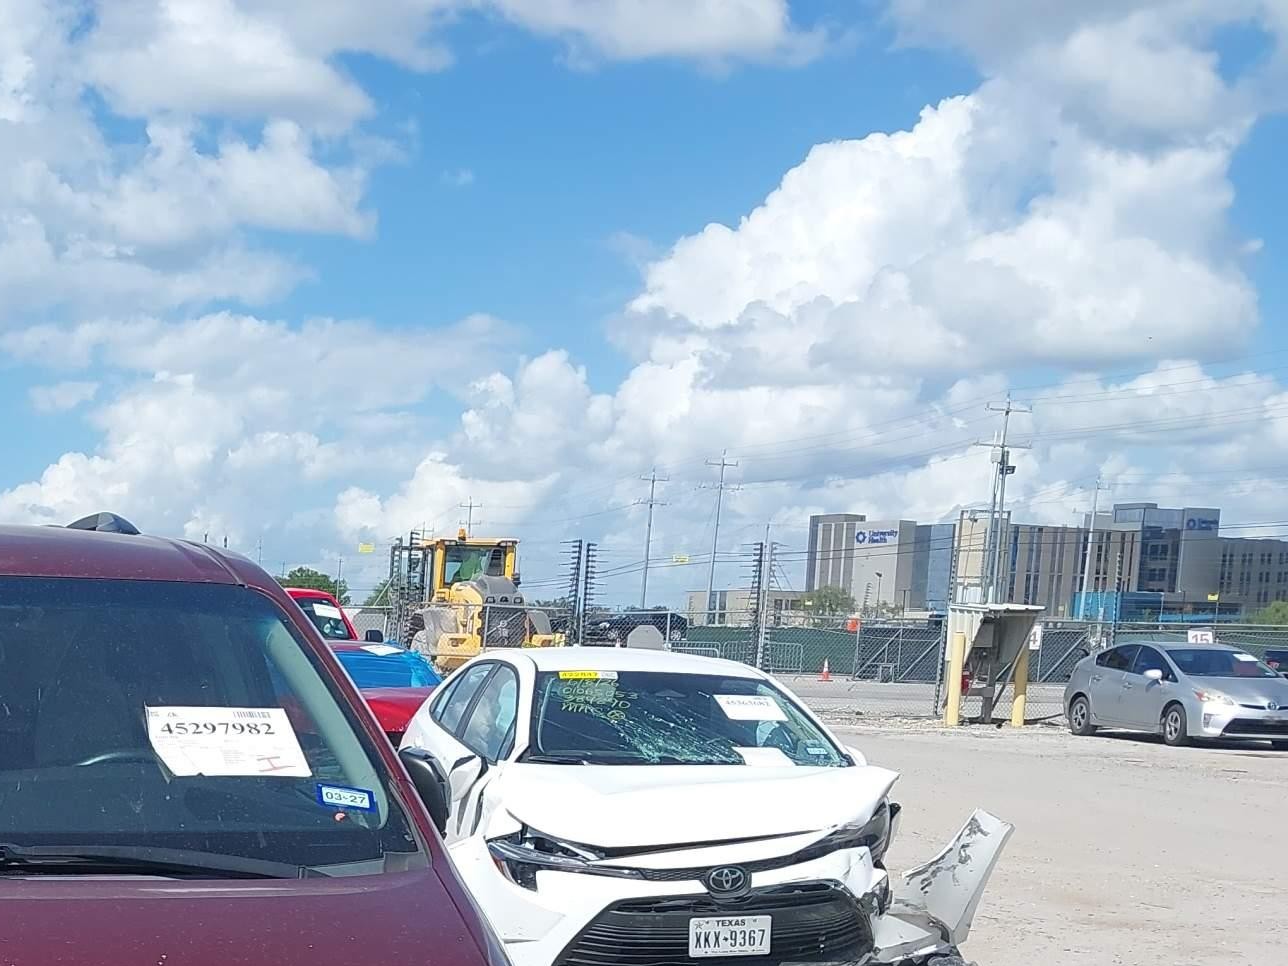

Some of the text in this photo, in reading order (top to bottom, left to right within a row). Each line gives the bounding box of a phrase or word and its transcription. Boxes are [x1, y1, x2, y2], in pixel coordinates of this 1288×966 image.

[161, 722, 276, 735] 45297982
[325, 791, 367, 804] 03-27
[715, 919, 746, 927] TEXAS
